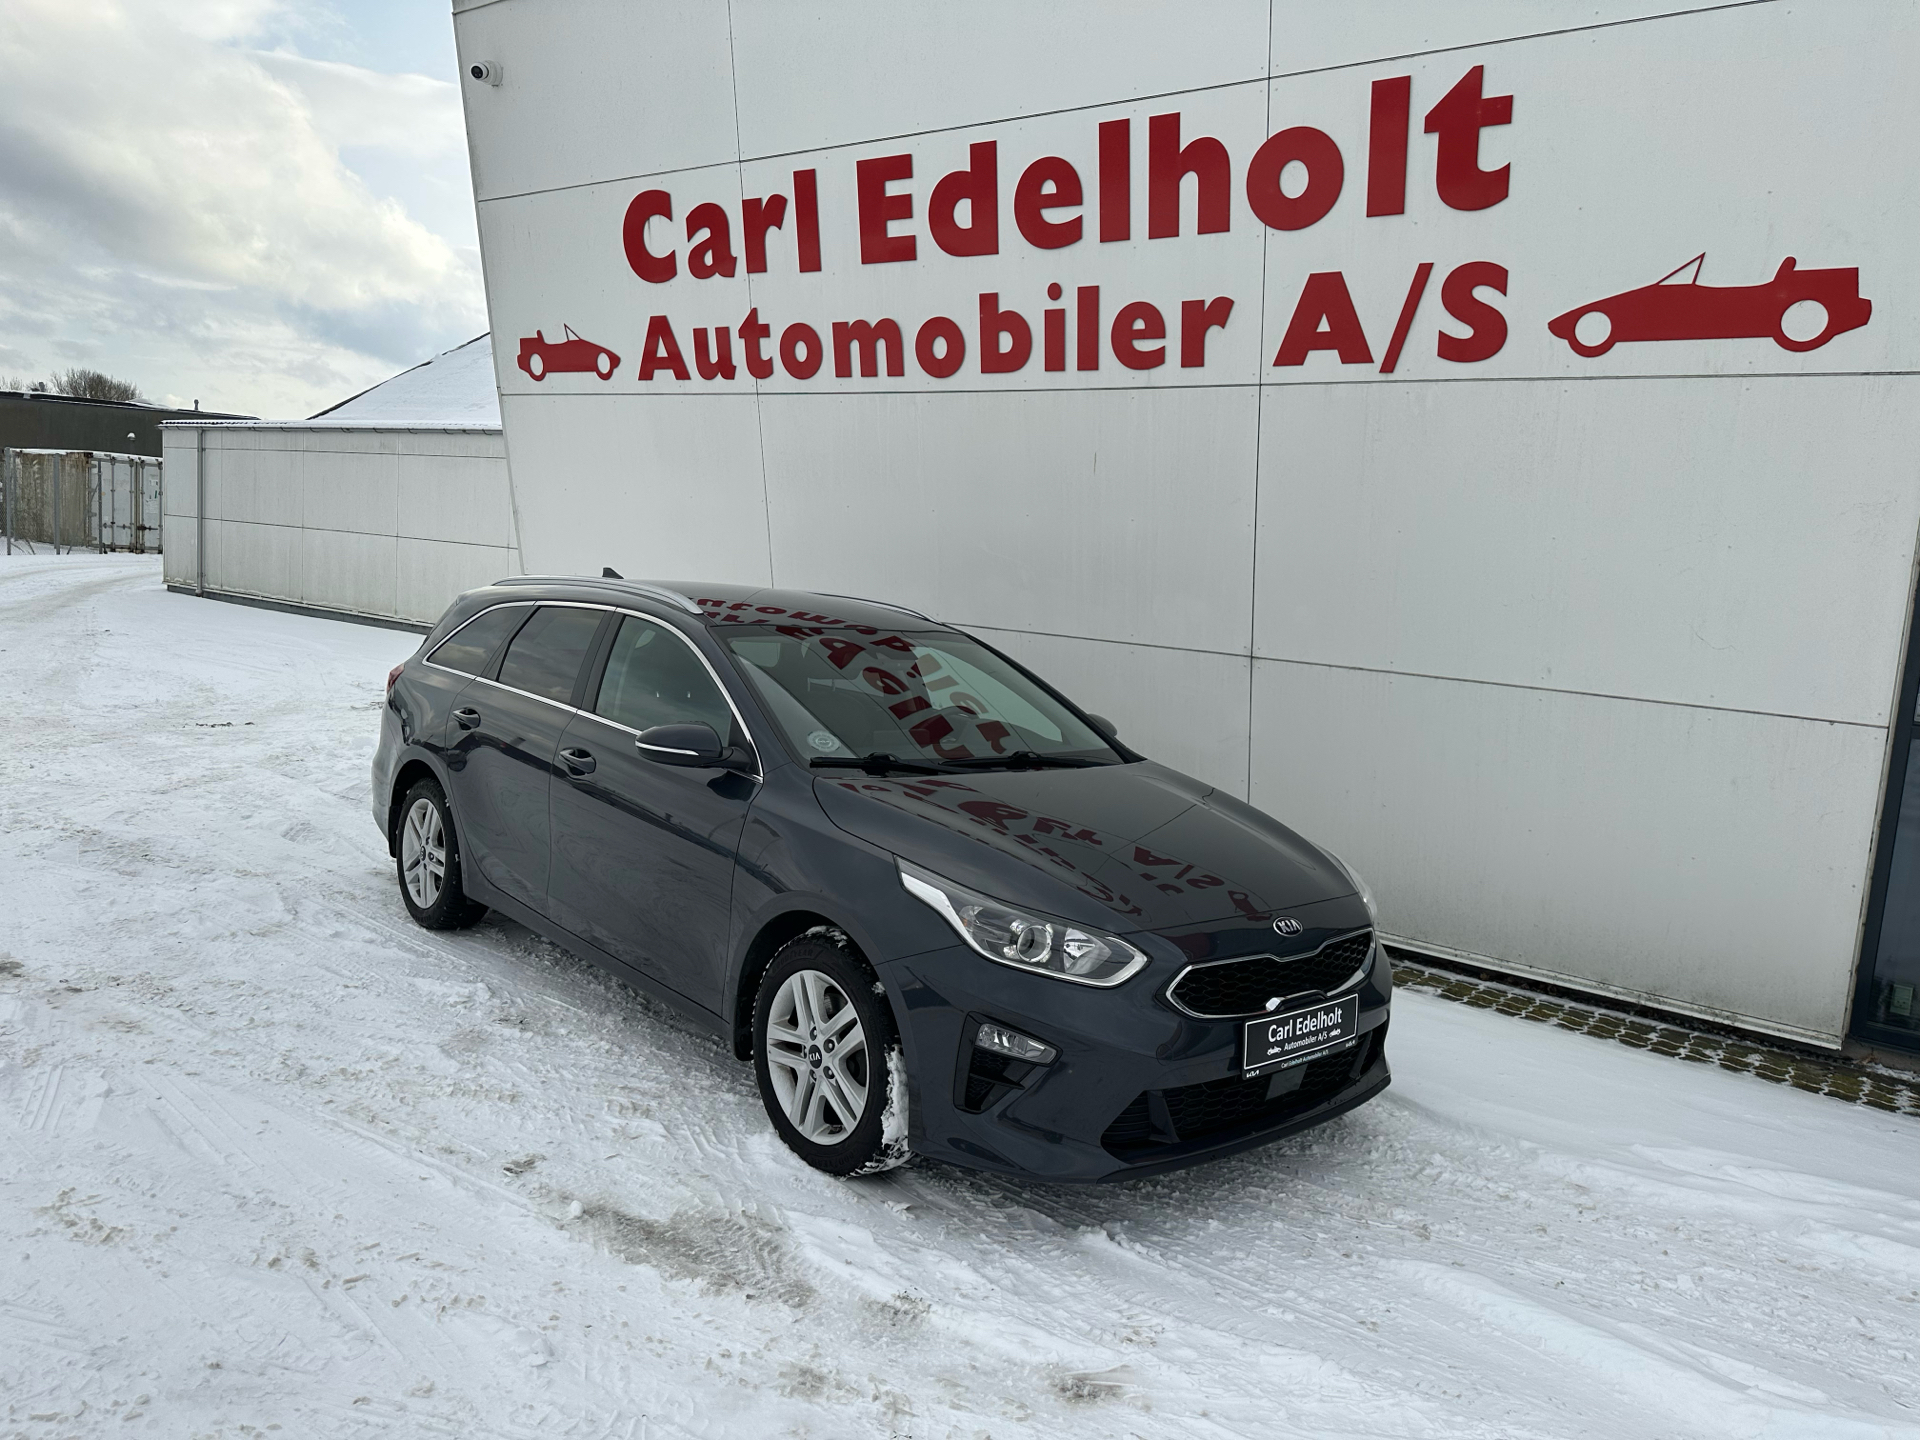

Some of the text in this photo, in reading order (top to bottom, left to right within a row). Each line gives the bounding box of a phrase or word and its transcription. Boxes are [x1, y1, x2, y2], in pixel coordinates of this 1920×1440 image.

[622, 64, 1513, 283] Carl Edelholt
[638, 261, 1508, 381] Automobiler A/S
[1276, 918, 1302, 934] KIA
[1268, 1007, 1343, 1043] Carl Edelholt
[1283, 1030, 1328, 1052] Automobiler A/S
[809, 1052, 821, 1061] KIA
